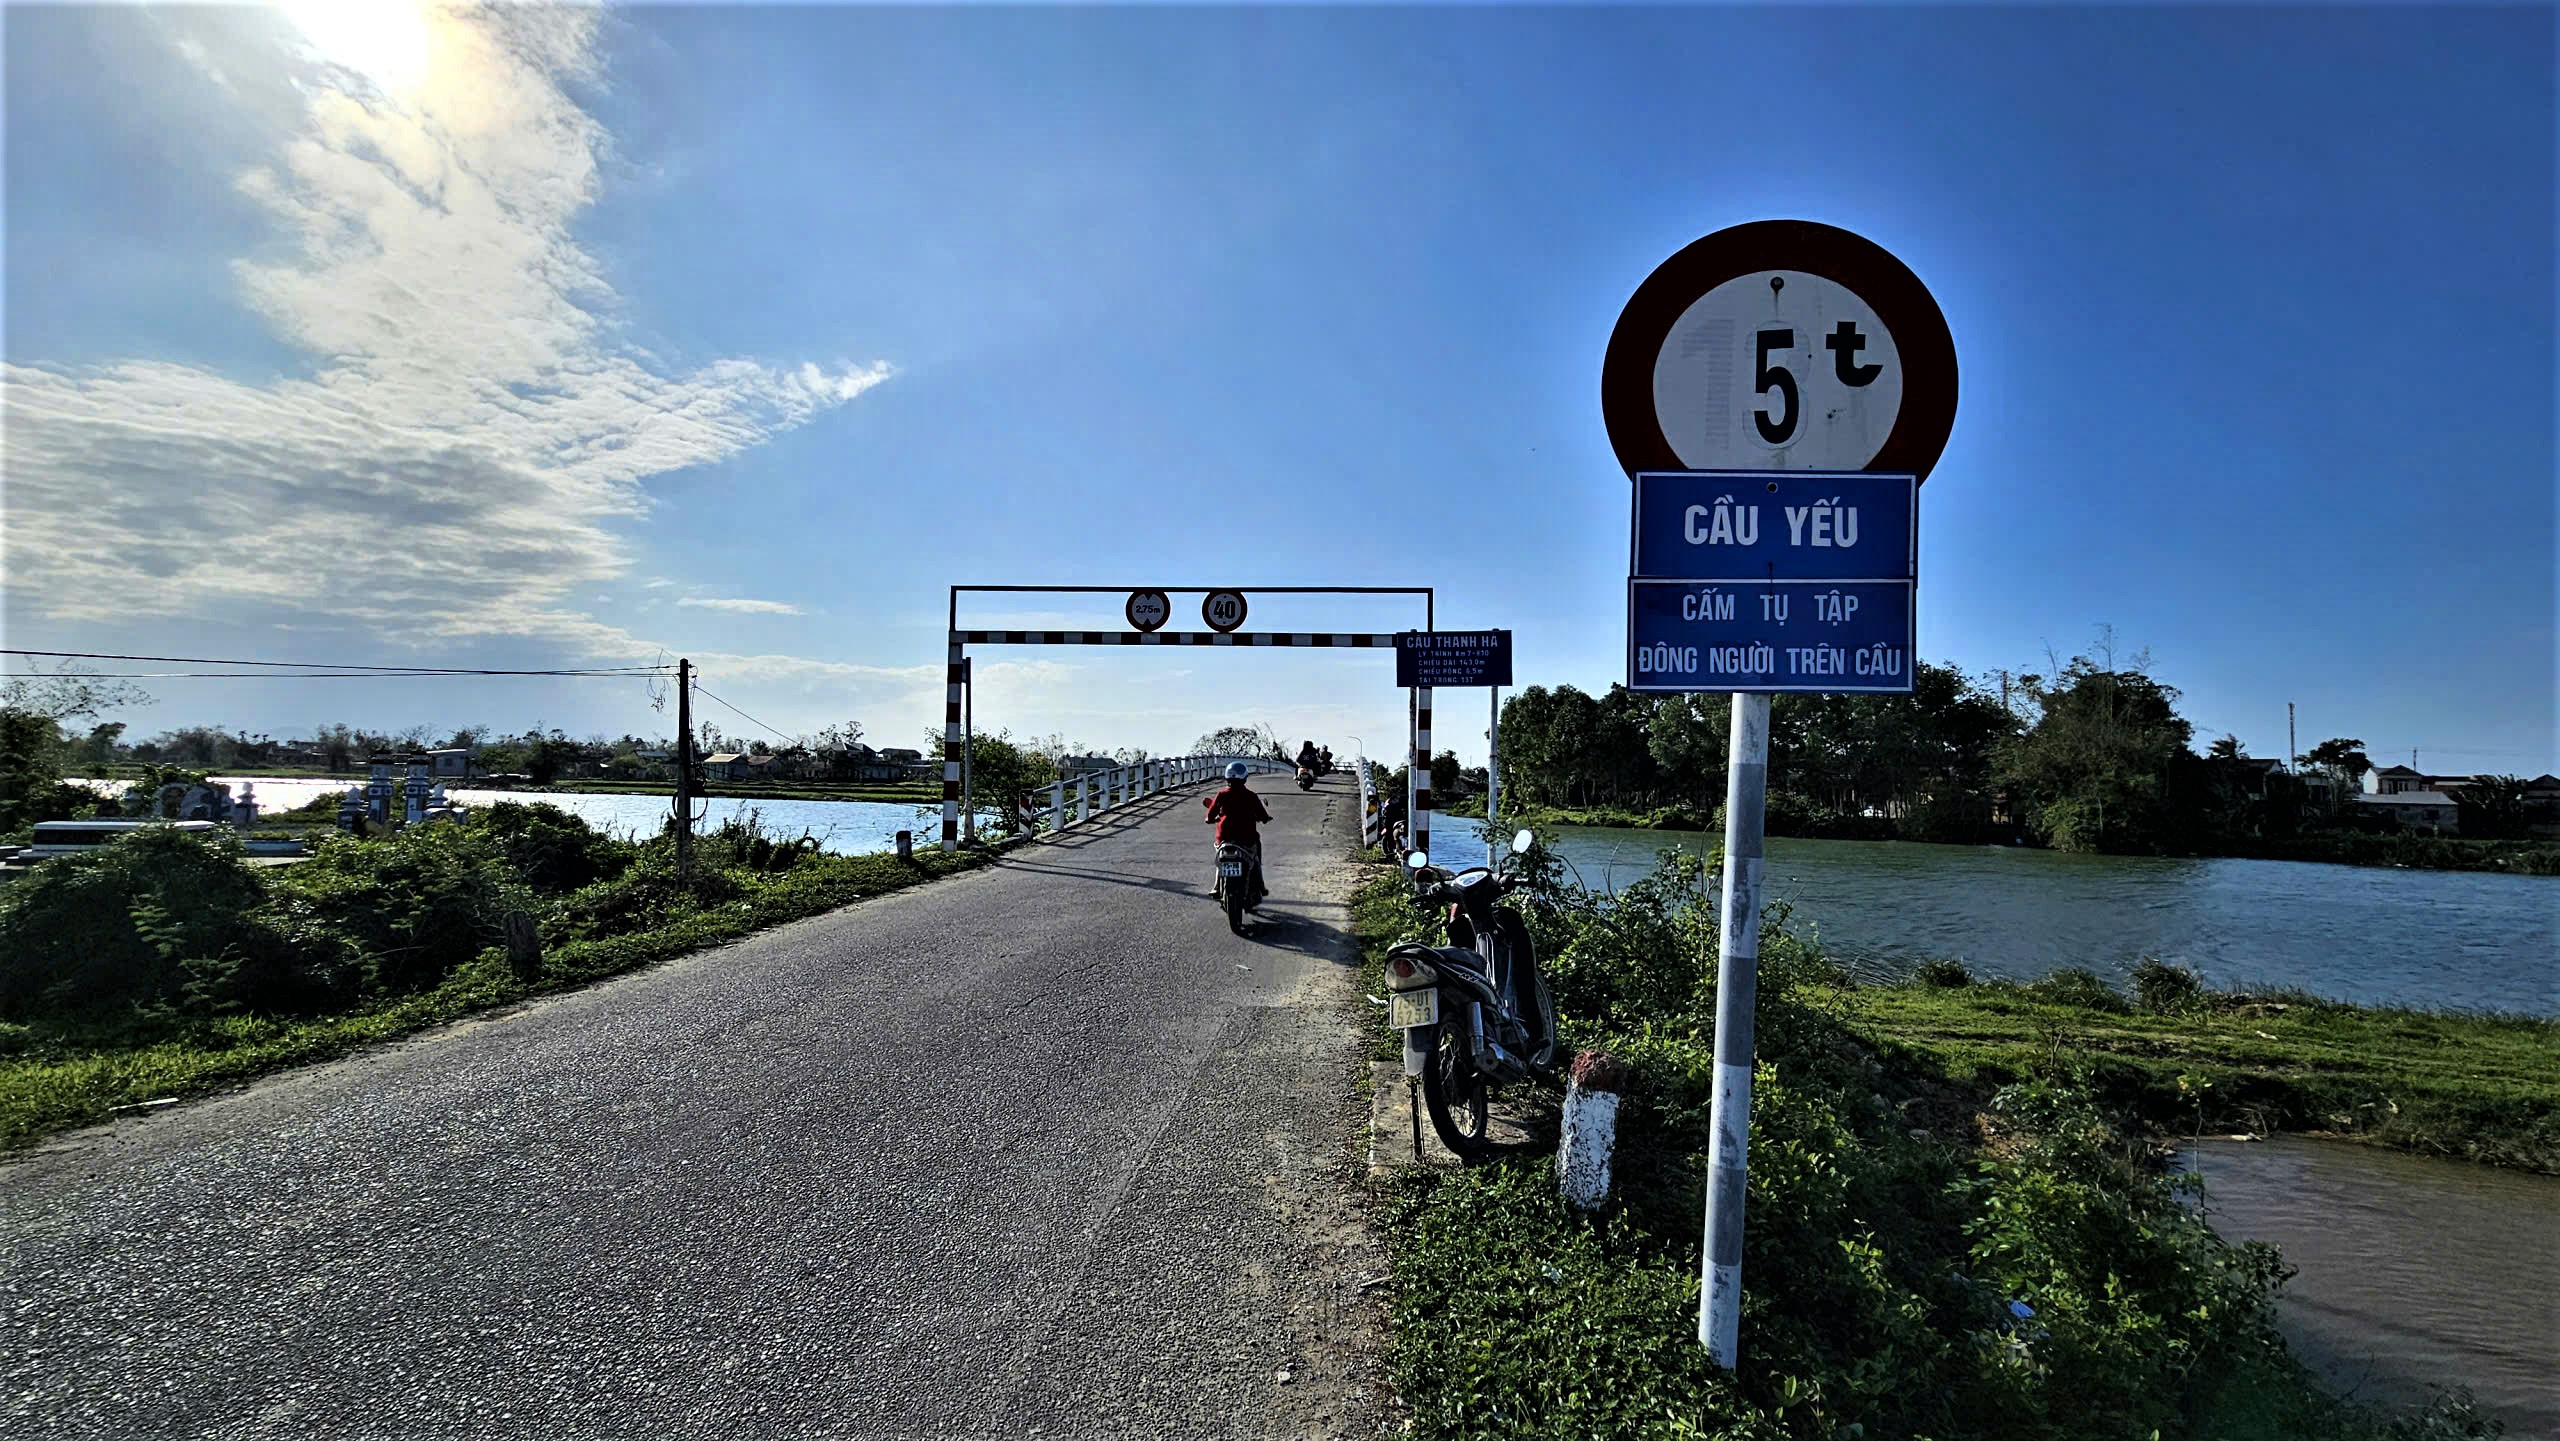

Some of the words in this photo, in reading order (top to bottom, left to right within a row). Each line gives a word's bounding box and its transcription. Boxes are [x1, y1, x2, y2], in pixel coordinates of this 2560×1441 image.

[1684, 494, 1759, 546] CẦU
[1784, 495, 1858, 548] YẾU
[1213, 601, 1236, 619] 40
[1682, 587, 1735, 621] CẤM
[1760, 593, 1789, 627] TỤ
[1814, 590, 1859, 627] TẬP
[1435, 635, 1477, 648] THANH
[1638, 641, 1698, 674] ĐÔNG
[1709, 643, 1775, 675] NGƯỜI
[1786, 643, 1846, 676] TRÊN
[1855, 640, 1902, 677] CẦU
